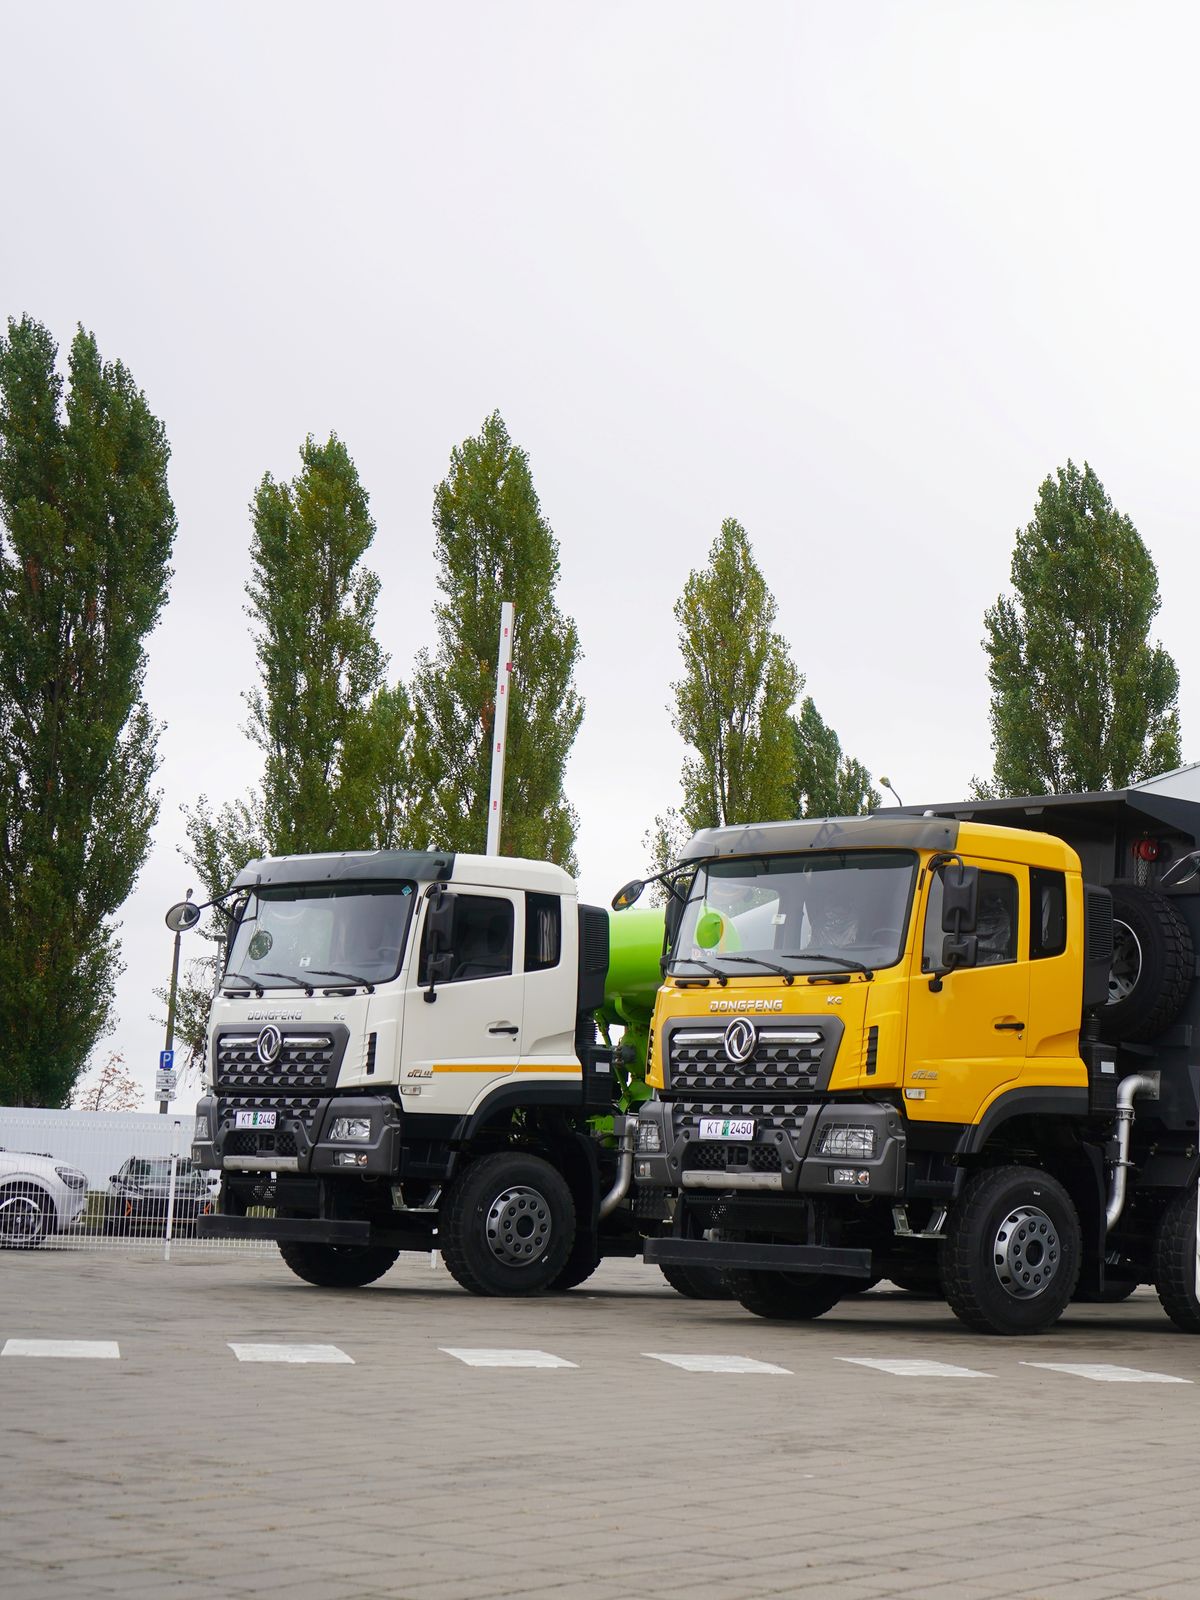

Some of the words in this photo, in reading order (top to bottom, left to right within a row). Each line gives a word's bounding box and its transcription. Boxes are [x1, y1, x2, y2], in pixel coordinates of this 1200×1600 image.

[709, 999, 783, 1013] DONGFENG
[826, 995, 843, 1006] KC
[247, 1008, 303, 1021] DONGFENG
[162, 1052, 172, 1068] P
[241, 1113, 251, 1125] KT
[259, 1113, 276, 1125] 2449
[707, 1121, 720, 1134] KT
[730, 1122, 752, 1135] 2450
